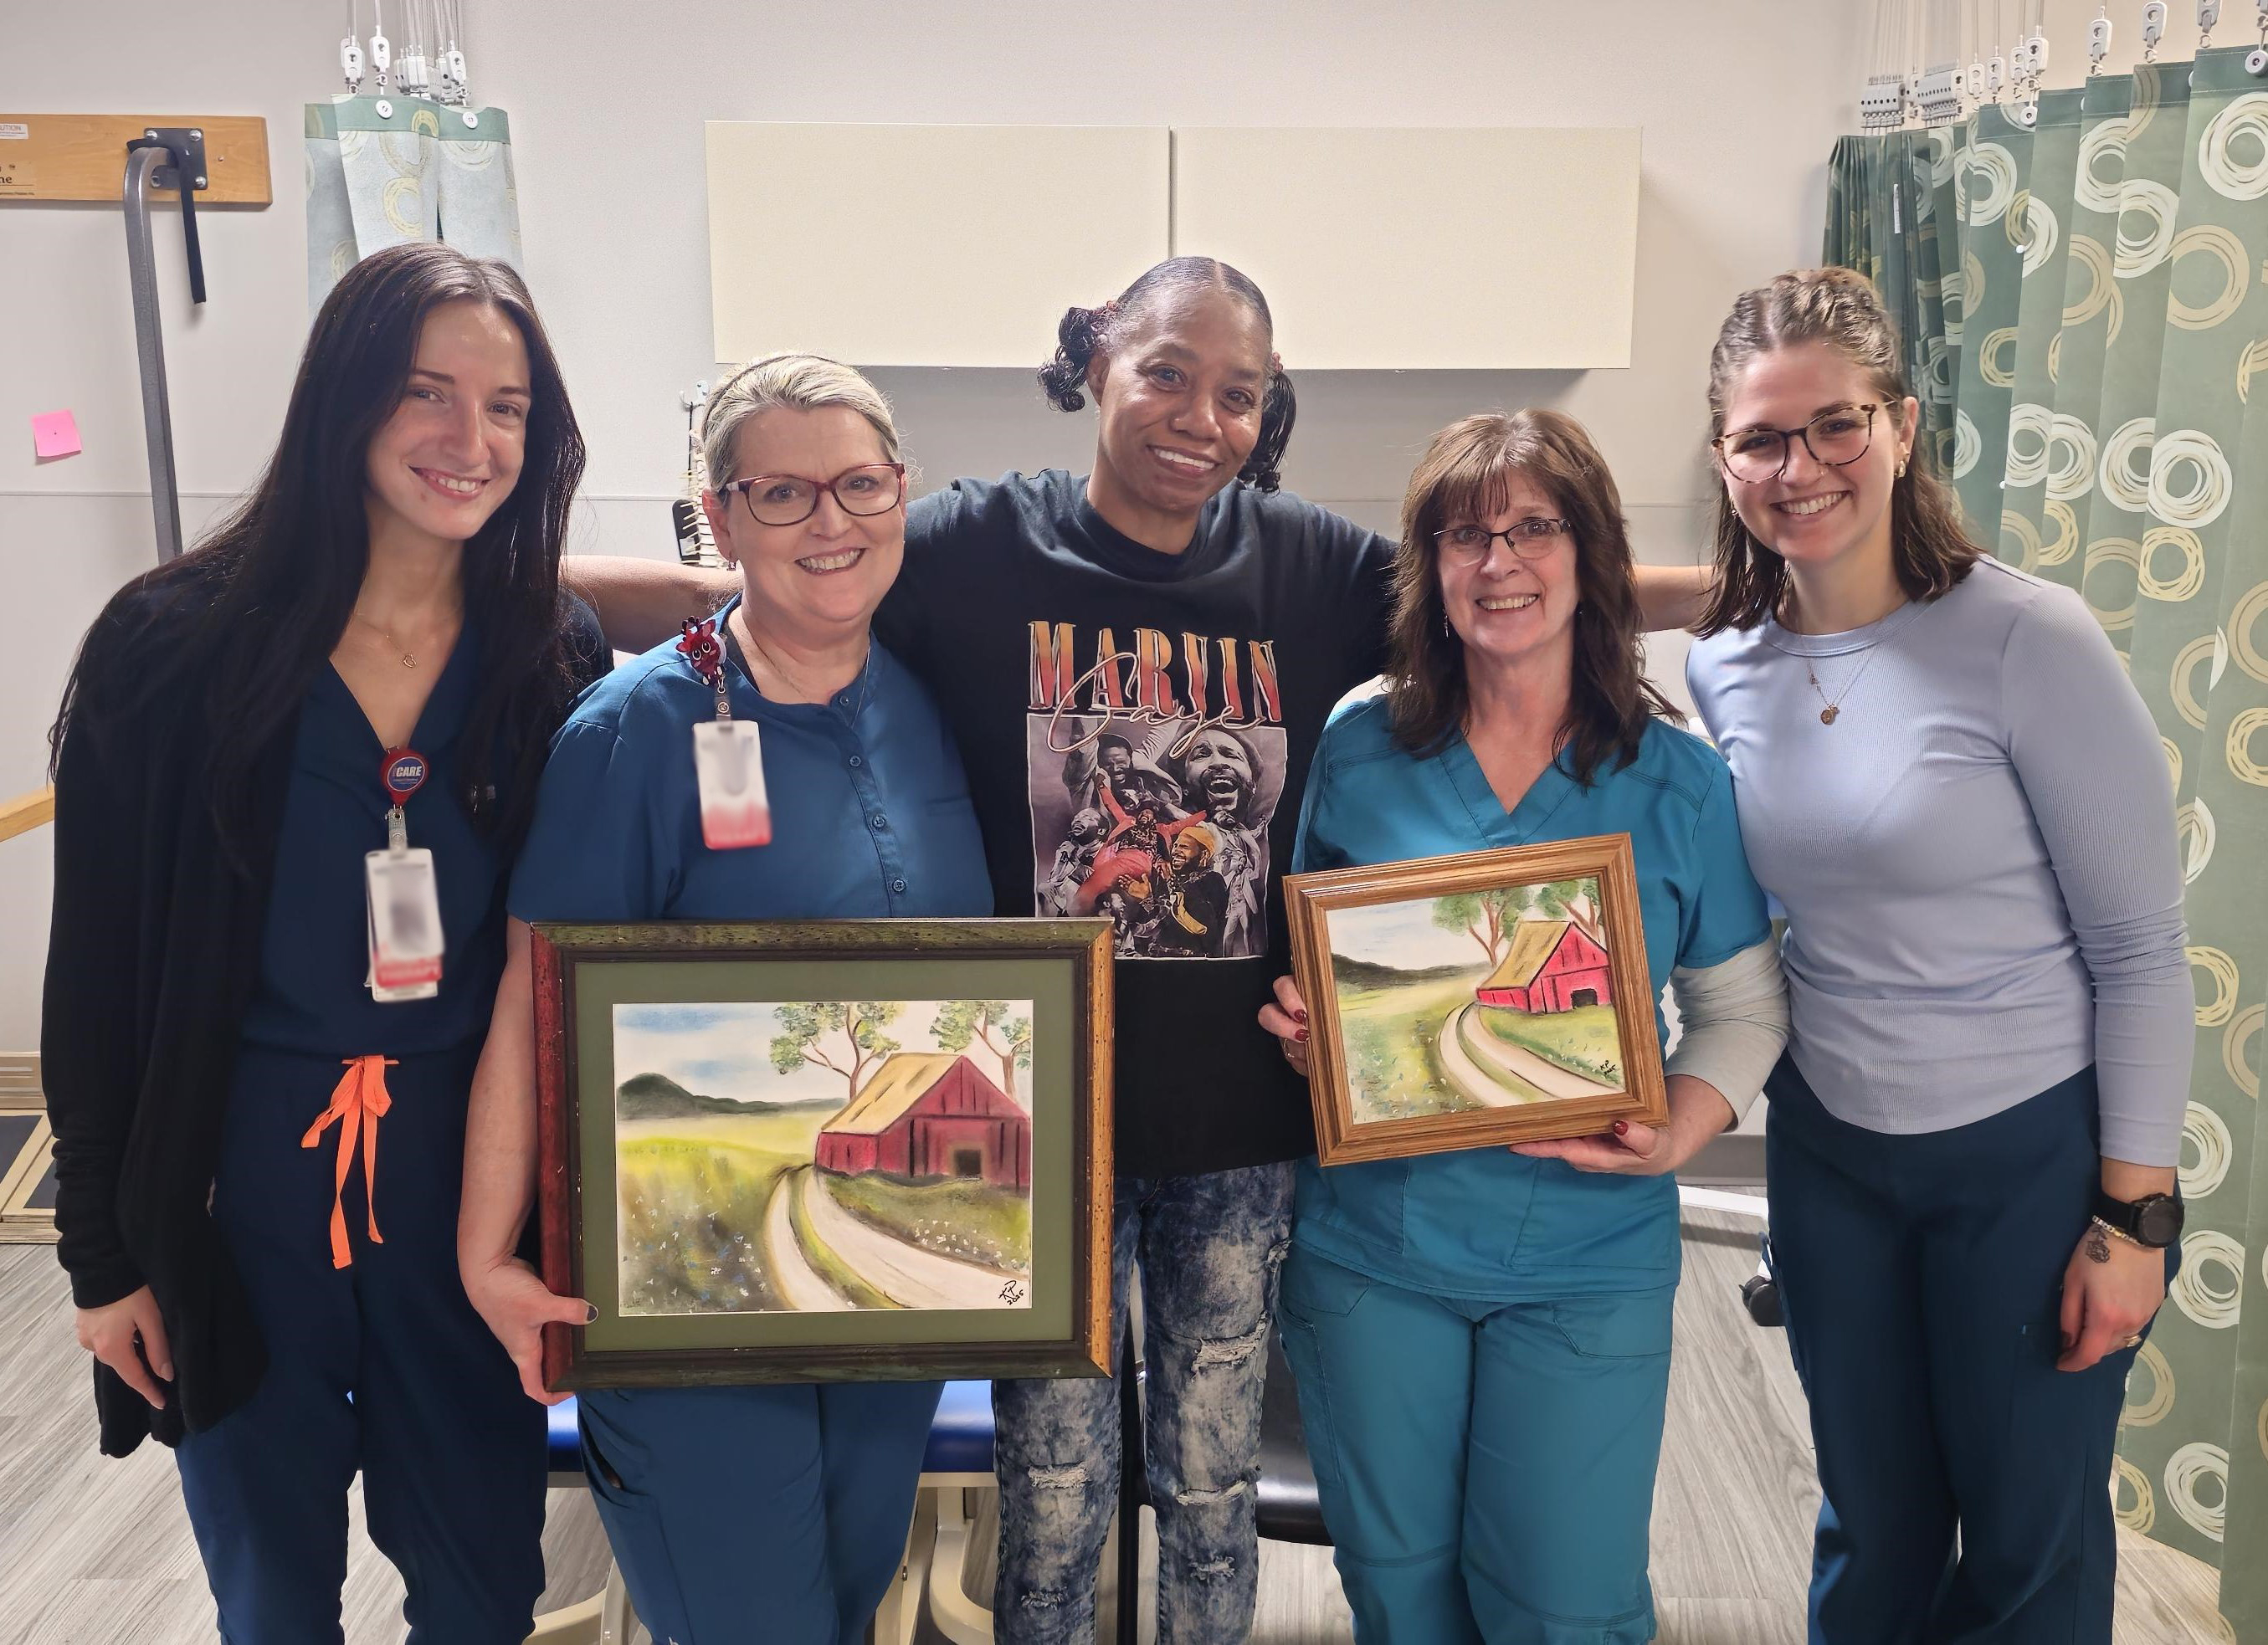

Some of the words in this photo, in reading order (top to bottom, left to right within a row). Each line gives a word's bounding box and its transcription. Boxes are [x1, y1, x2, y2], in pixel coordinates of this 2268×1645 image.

[1028, 621, 1281, 722] MARVIN
[1047, 652, 1266, 758] Gaye
[397, 766, 423, 777] CARE
